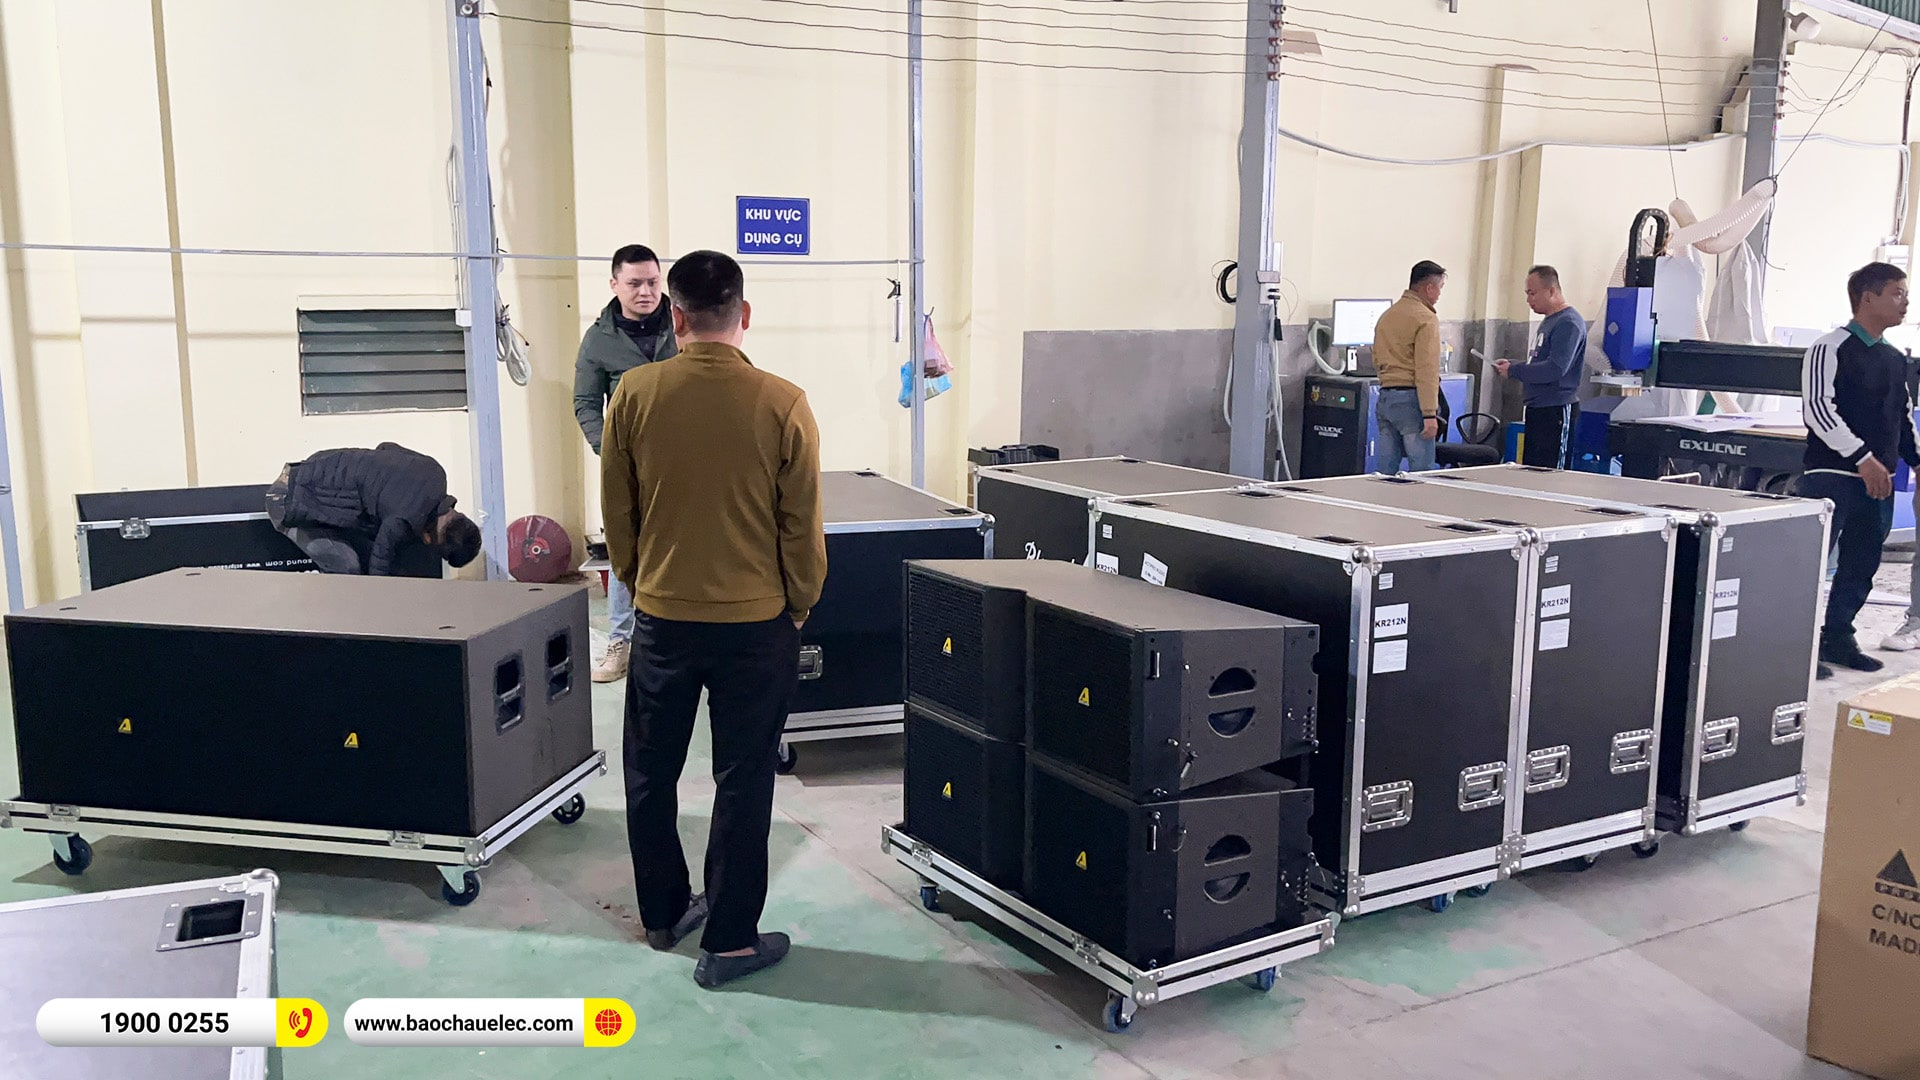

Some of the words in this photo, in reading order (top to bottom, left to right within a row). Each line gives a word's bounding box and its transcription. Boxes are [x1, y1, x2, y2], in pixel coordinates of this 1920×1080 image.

[745, 208, 772, 220] KHU
[774, 208, 802, 224] VỰC
[744, 232, 782, 247] DỤNG
[783, 233, 803, 248] CỤ
[1679, 439, 1748, 456] GXUCNC
[1541, 597, 1569, 609] KR212N
[1374, 617, 1407, 628] KR212N
[1868, 927, 1920, 955] MAD
